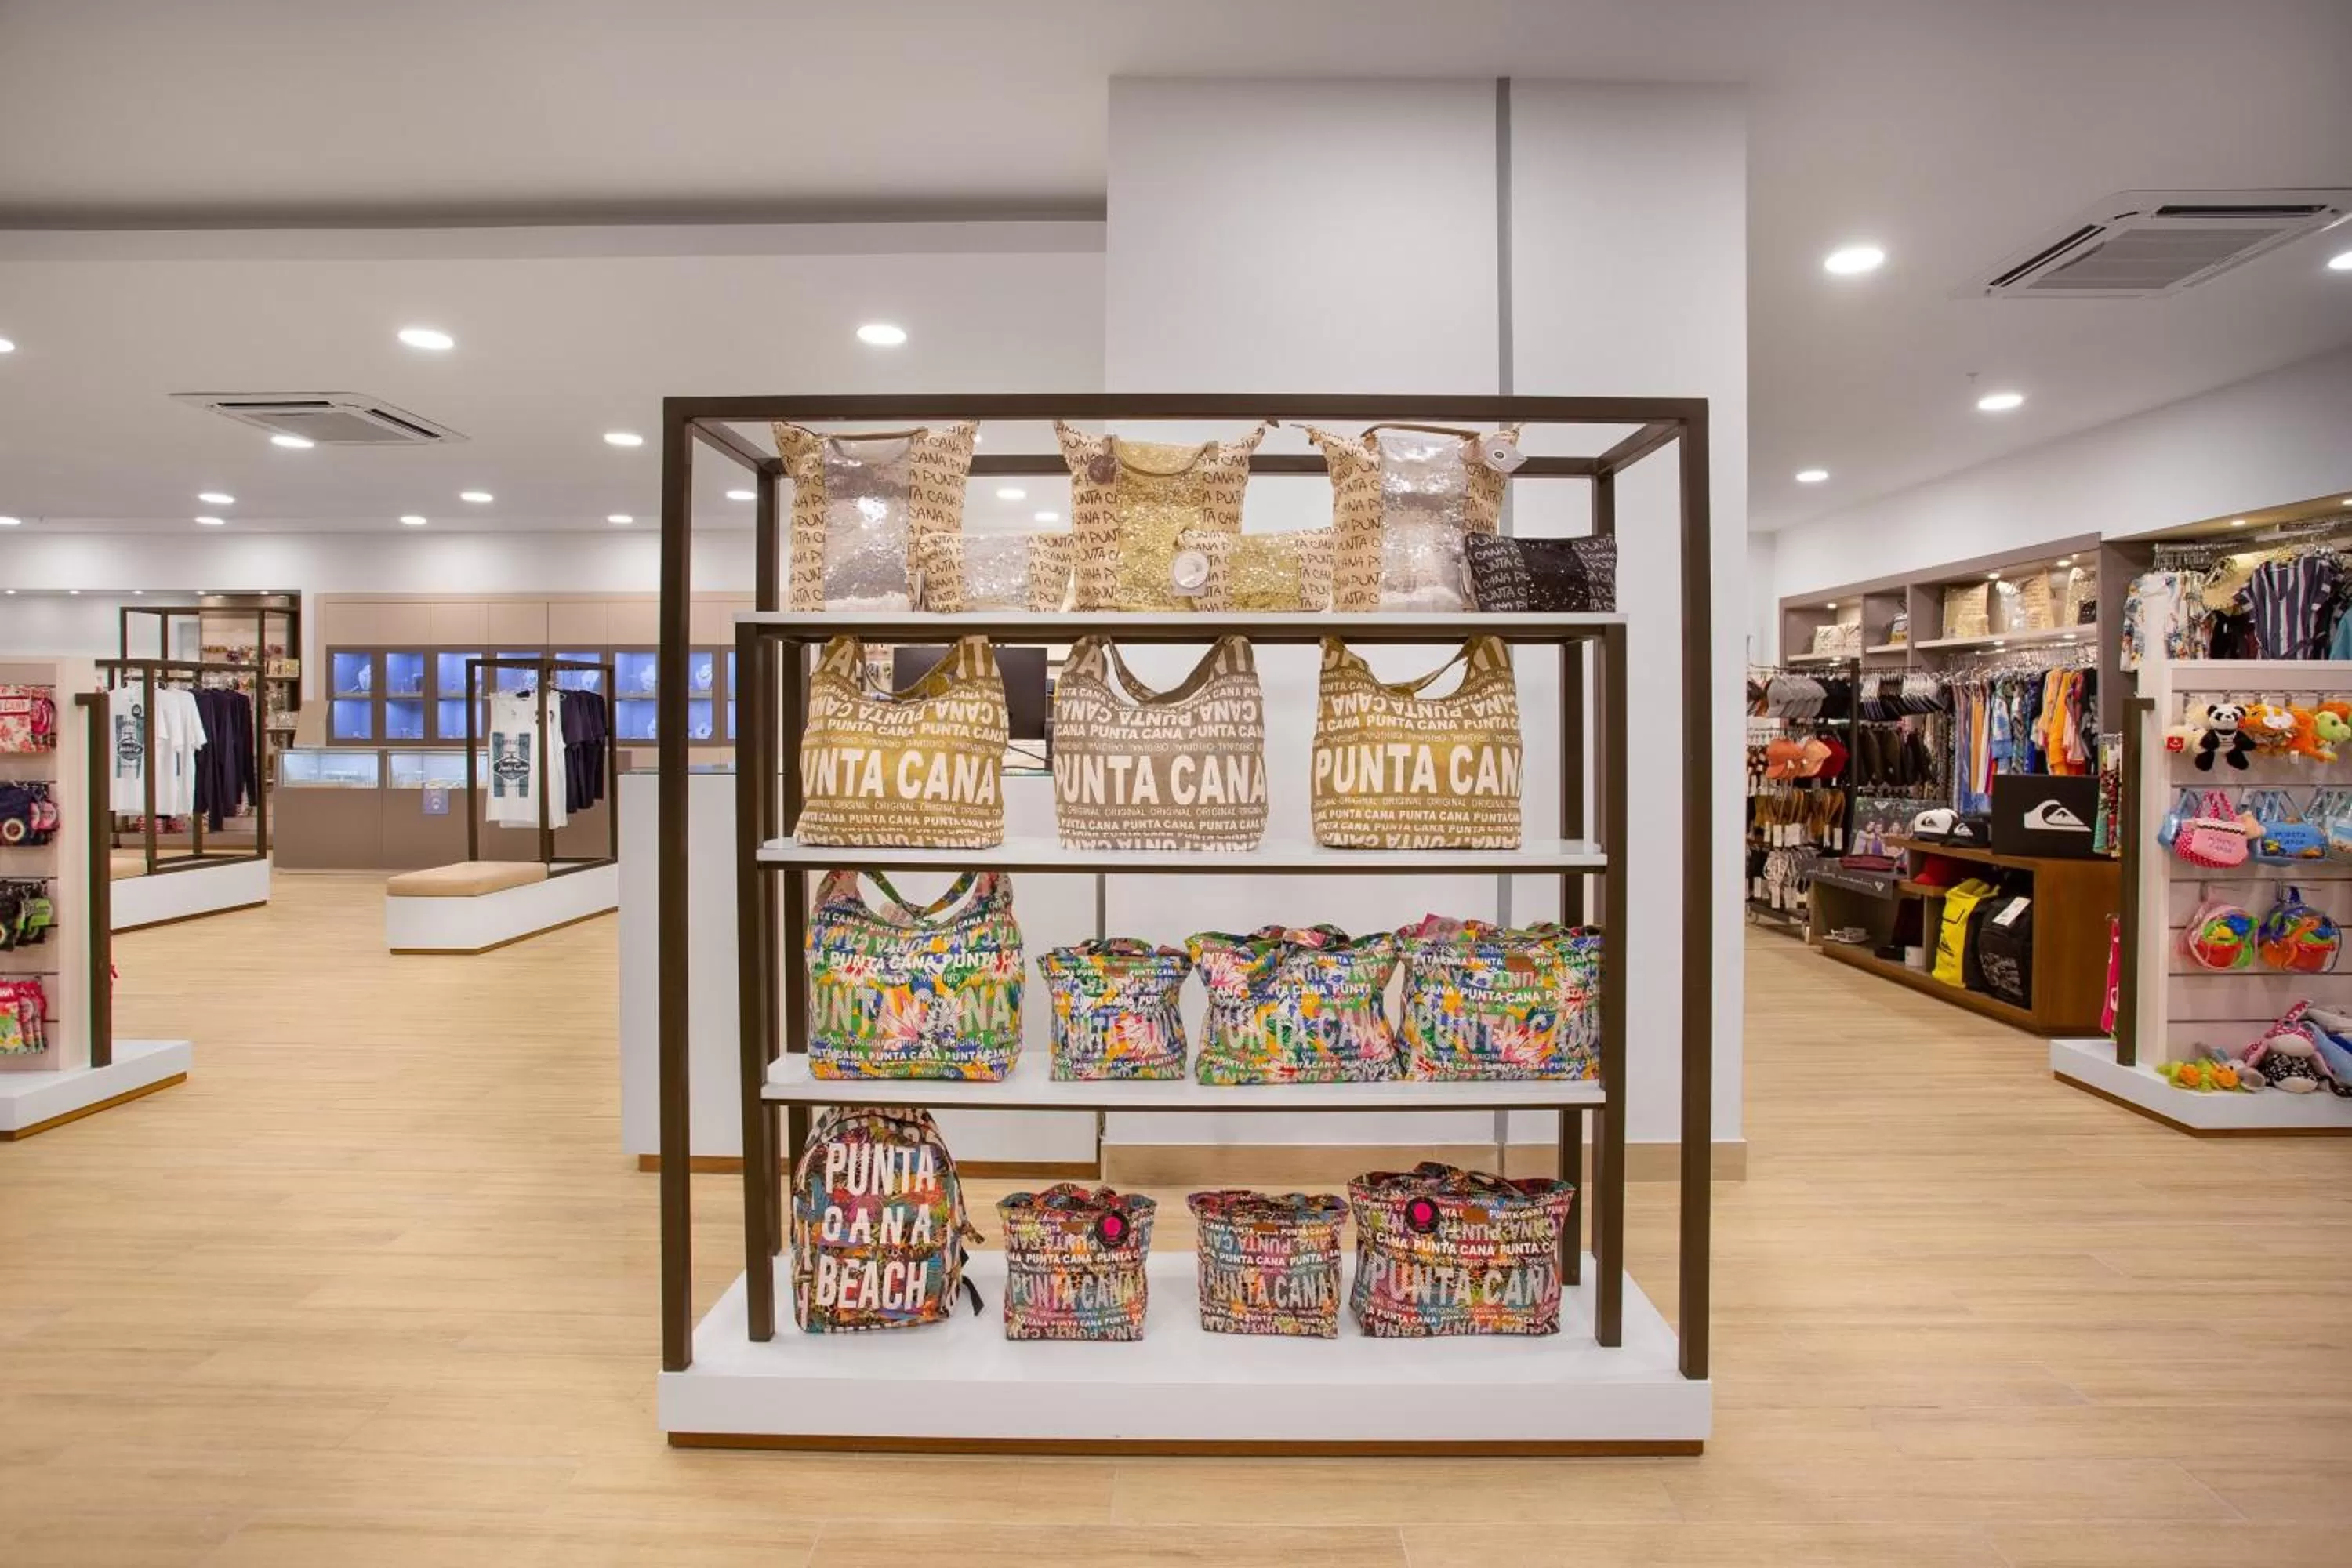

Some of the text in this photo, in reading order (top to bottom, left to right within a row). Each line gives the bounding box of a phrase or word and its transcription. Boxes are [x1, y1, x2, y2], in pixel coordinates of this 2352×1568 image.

[1321, 681, 1347, 694] UNTA
[1061, 699, 1112, 724] CANA
[1119, 710, 1192, 728] PUNTA
[1390, 699, 1463, 720] PUNTA
[828, 717, 874, 733] PUNTA
[920, 721, 970, 739] PUNTA
[973, 726, 1004, 745] CANA
[1055, 724, 1237, 740] CANA PUNTA CANA PUNTA
[1327, 714, 1509, 731] CANA PUNTA CANA PUNTA
[800, 747, 996, 805] UNTA CANA
[1053, 753, 1267, 805] PUNTA CANA
[1314, 744, 1438, 796] PUNTA
[849, 814, 886, 824] PUNTA
[888, 815, 920, 826] CANA
[923, 816, 961, 826] PUNTA
[1088, 818, 1120, 831] CANA
[1123, 818, 1162, 830] PUNTA
[1163, 819, 1196, 831] CANA
[1199, 820, 1238, 831] PUNTA
[1328, 808, 1507, 823] PUNTA CANA PUNTA CANA PUNTA
[830, 949, 999, 972] PUNTA CANA PUNTA
[1292, 982, 1371, 995] CANA PUNTA
[1460, 988, 1503, 1001] PUNTA
[1504, 990, 1541, 1003] CANA
[868, 1050, 908, 1061] PUNTA
[909, 1051, 942, 1061] CANA
[825, 1142, 937, 1196] PUNTA
[822, 1203, 933, 1246] CANA
[1376, 1232, 1541, 1256] CANA PUNTA CANA PUNTA
[1026, 1252, 1132, 1265] PUNTA CANA PUNTA
[1219, 1254, 1323, 1265] PUNTA CANA PUNTA
[815, 1254, 929, 1311] BEACH
[1273, 1271, 1329, 1308] CANA
[1365, 1260, 1560, 1305] PUNTA CANA
[1377, 1308, 1410, 1323] PUNTA
